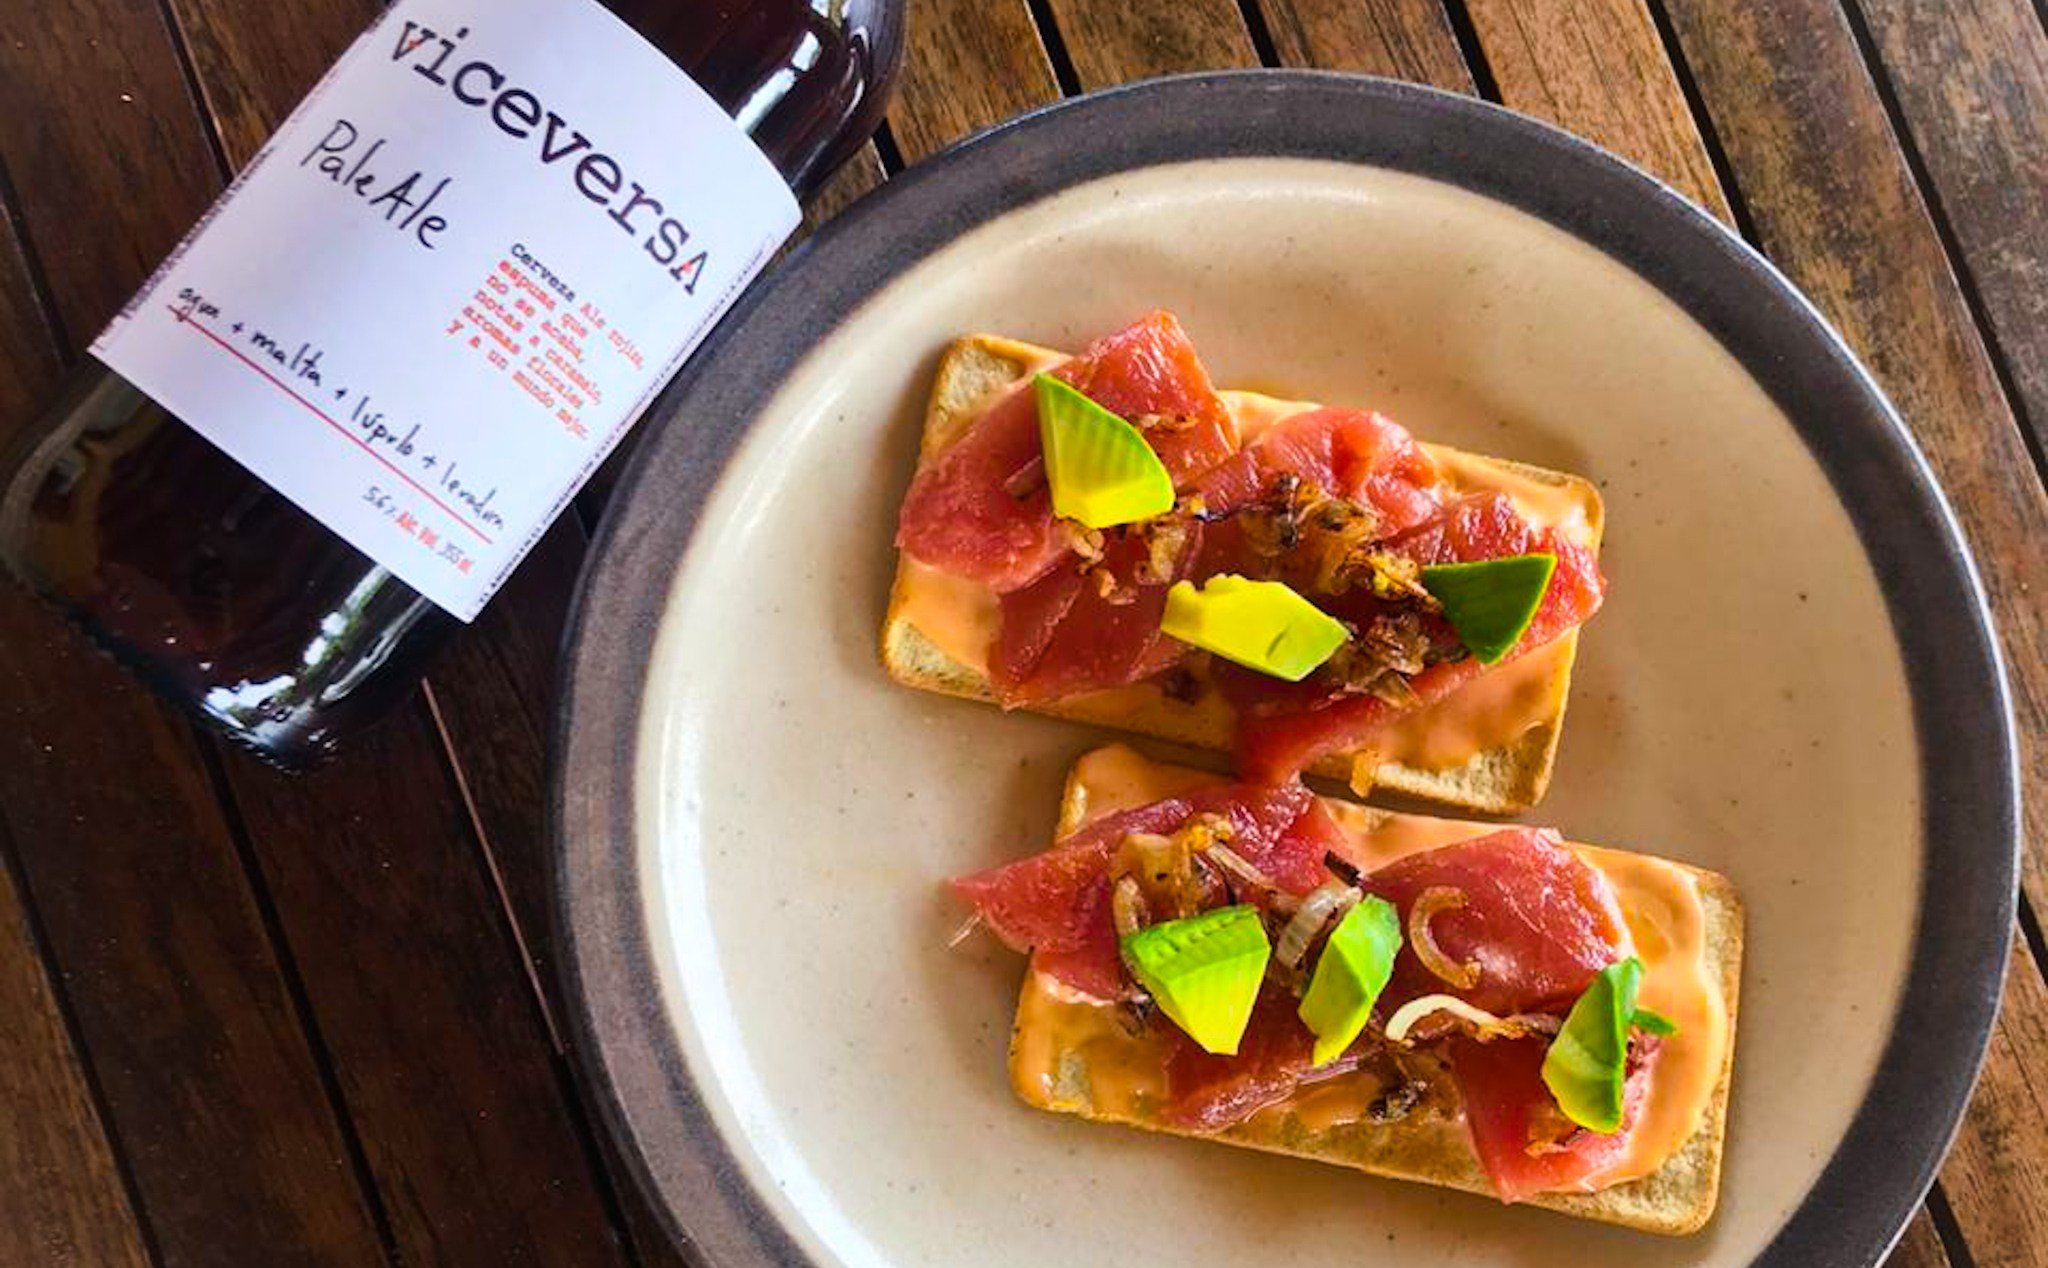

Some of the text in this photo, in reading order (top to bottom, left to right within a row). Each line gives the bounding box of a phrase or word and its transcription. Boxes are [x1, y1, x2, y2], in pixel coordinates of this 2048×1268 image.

[300, 118, 387, 197] Pale
[368, 171, 452, 250] Ale
[486, 275, 509, 295] no
[510, 242, 576, 302] Cerveza
[474, 290, 523, 332] notas
[250, 331, 324, 386] malta
